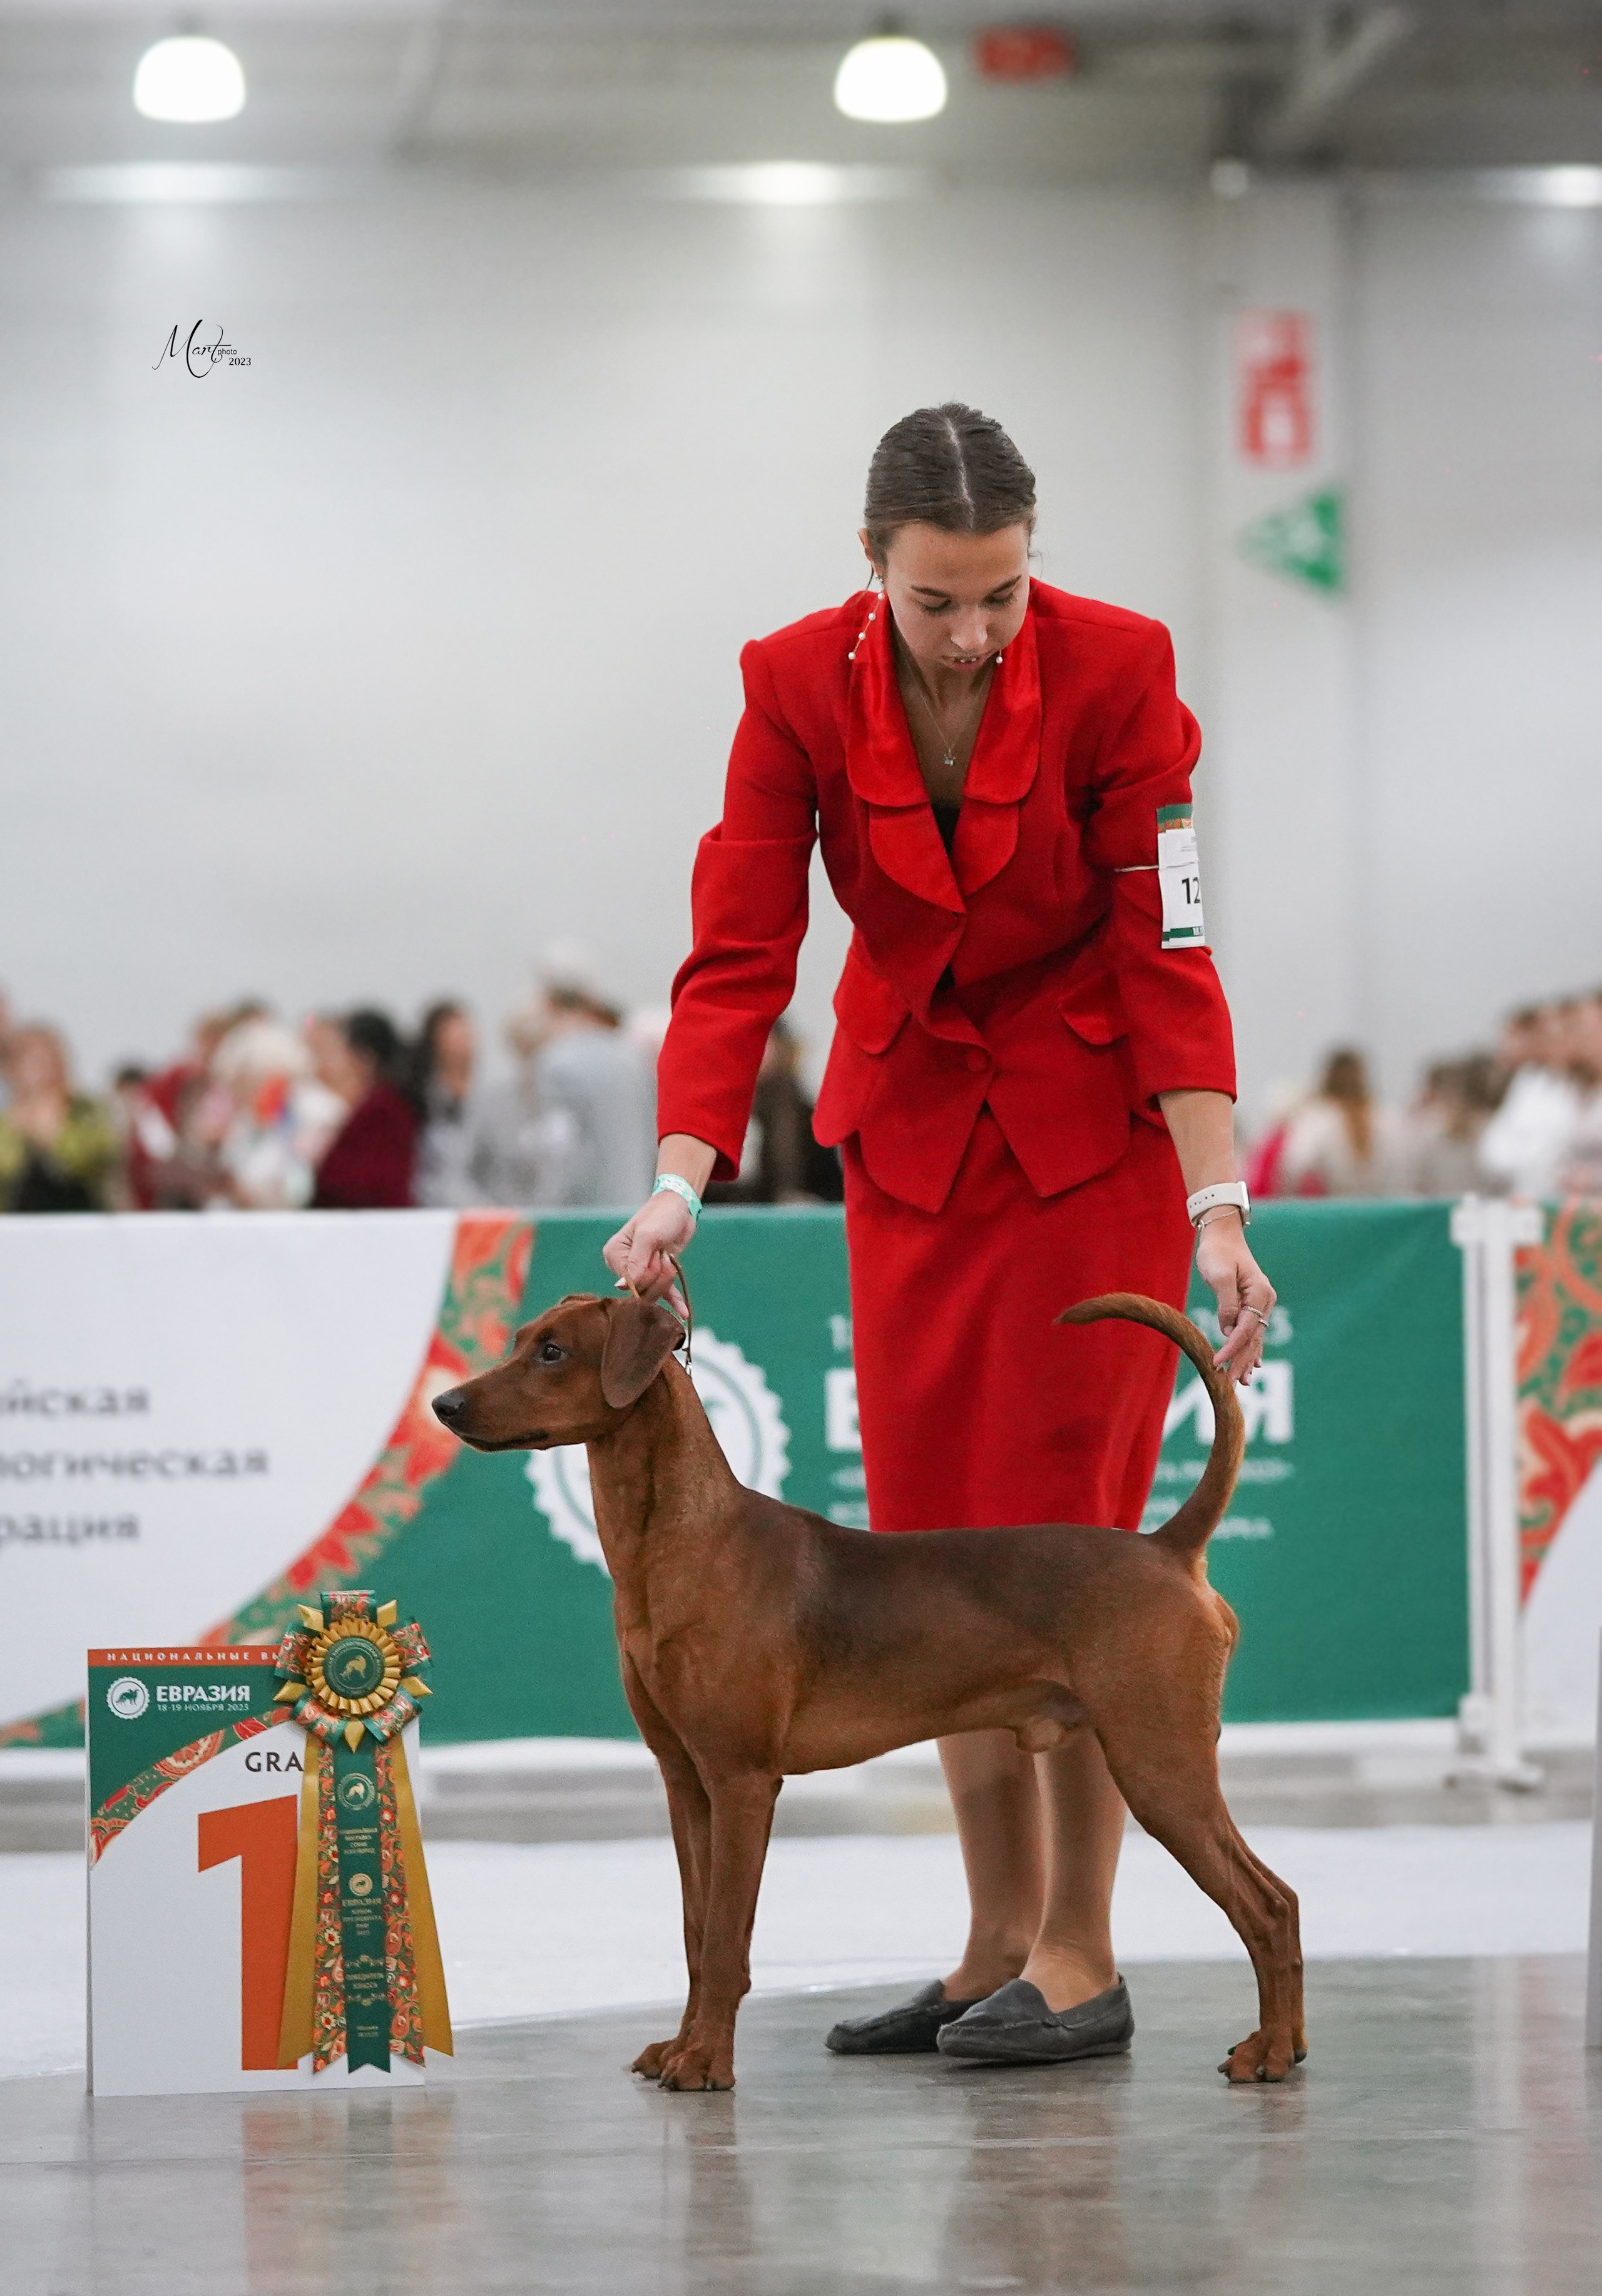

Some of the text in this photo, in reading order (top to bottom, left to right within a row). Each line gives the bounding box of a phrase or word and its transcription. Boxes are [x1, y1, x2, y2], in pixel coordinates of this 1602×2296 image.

[0, 1448, 269, 1478] огическая
[107, 1652, 250, 1662] НАЦИОНАЛЬНЫЕ
[156, 1685, 250, 1702] ЕВРАЗИЯ
[245, 1751, 305, 1772] GRA
[198, 1795, 298, 2071] 1
